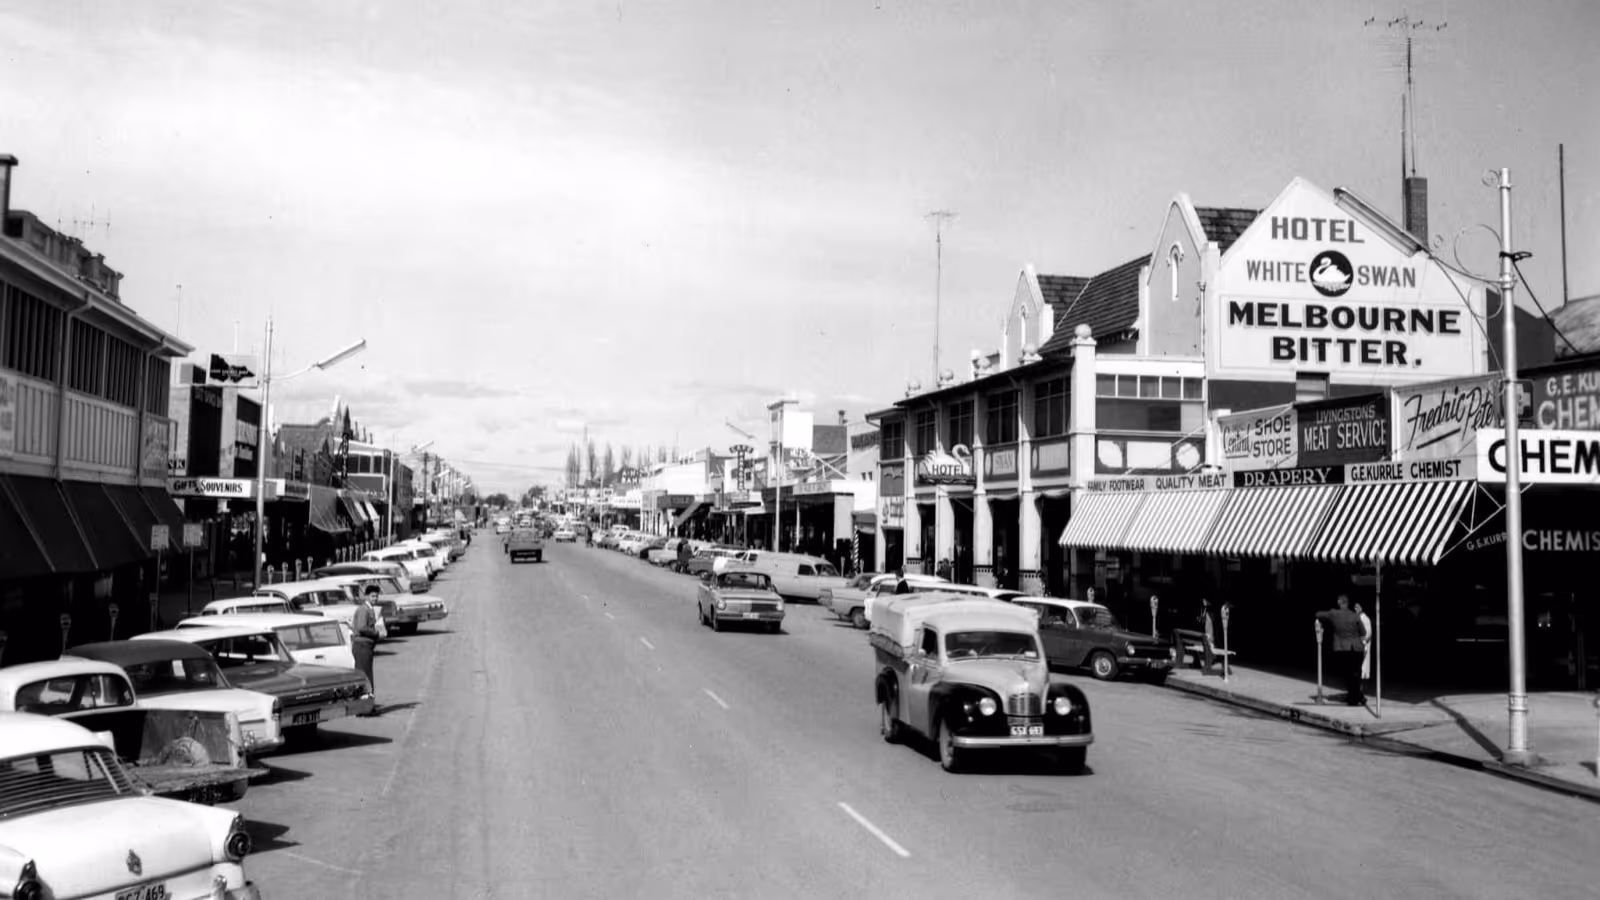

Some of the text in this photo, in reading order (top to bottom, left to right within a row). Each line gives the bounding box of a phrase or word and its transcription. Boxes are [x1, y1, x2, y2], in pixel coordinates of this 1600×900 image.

[1271, 216, 1365, 243] HOTEL
[1247, 259, 1416, 288] WHITE SWAN
[1229, 301, 1461, 334] MELBOURNE
[1271, 336, 1422, 366] BITTER.
[1316, 404, 1376, 424] LIVINGSTONS
[1404, 386, 1466, 451] Fredric
[1254, 415, 1291, 436] SHOE
[1304, 419, 1386, 452] MEAT SERVICE
[1253, 437, 1291, 458] STORE
[1488, 439, 1600, 474] CHEM
[932, 464, 964, 476] HOTEL
[1244, 467, 1332, 487] DRAPERY
[1410, 460, 1461, 479] CHEMIST
[201, 480, 242, 493] SOUVENIRS
[1088, 479, 1145, 492] FAMILY FOOTWEAR
[1156, 474, 1227, 489] QUALITY MEAT
[1522, 529, 1600, 551] CHEMIS
